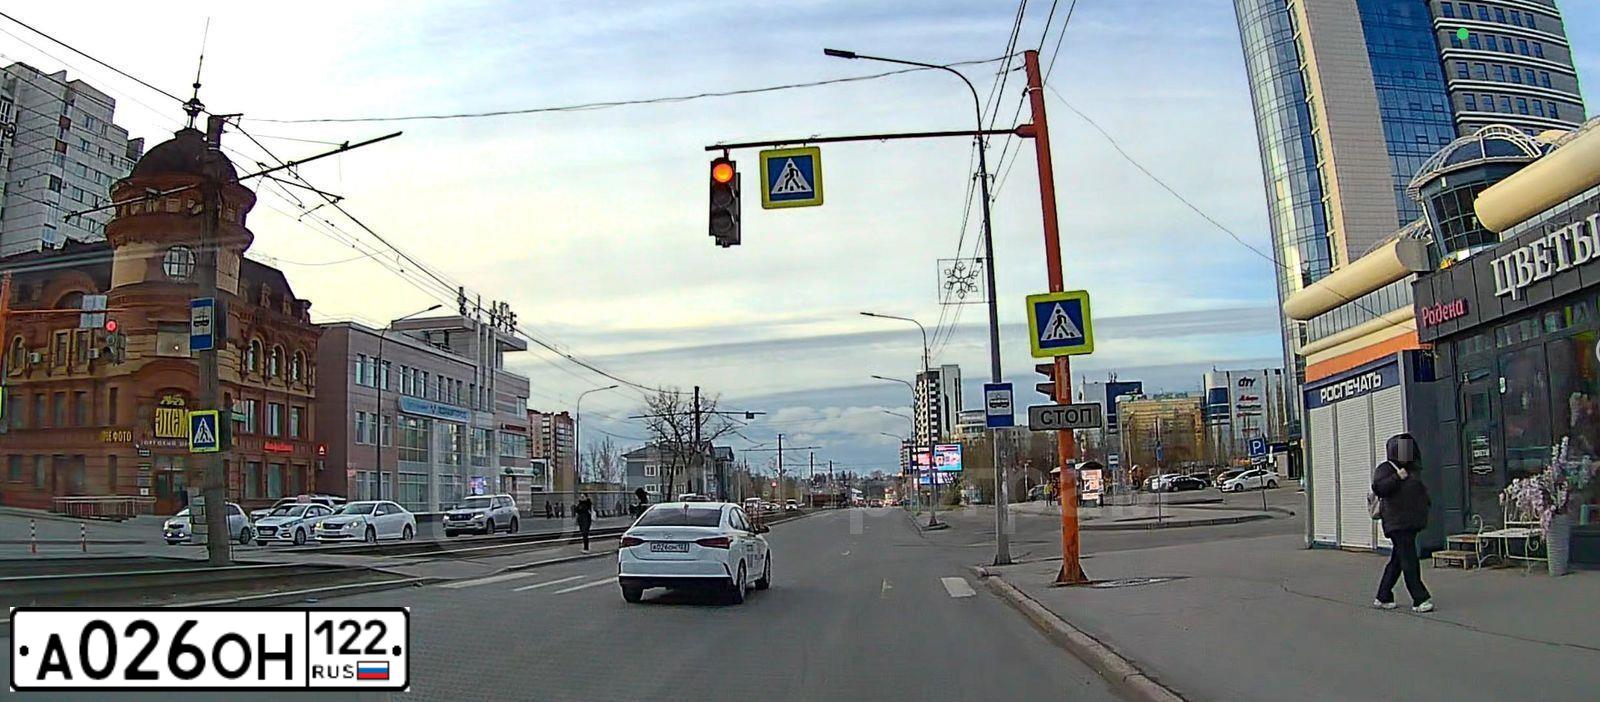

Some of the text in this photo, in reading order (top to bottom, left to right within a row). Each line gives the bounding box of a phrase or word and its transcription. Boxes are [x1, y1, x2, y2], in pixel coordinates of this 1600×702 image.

[1490, 213, 1600, 300] ЦВЕТЫ
[1422, 299, 1465, 327] Родена
[1320, 371, 1382, 404] РОСПЕЧАТЬ
[1041, 408, 1091, 425] СТОП
